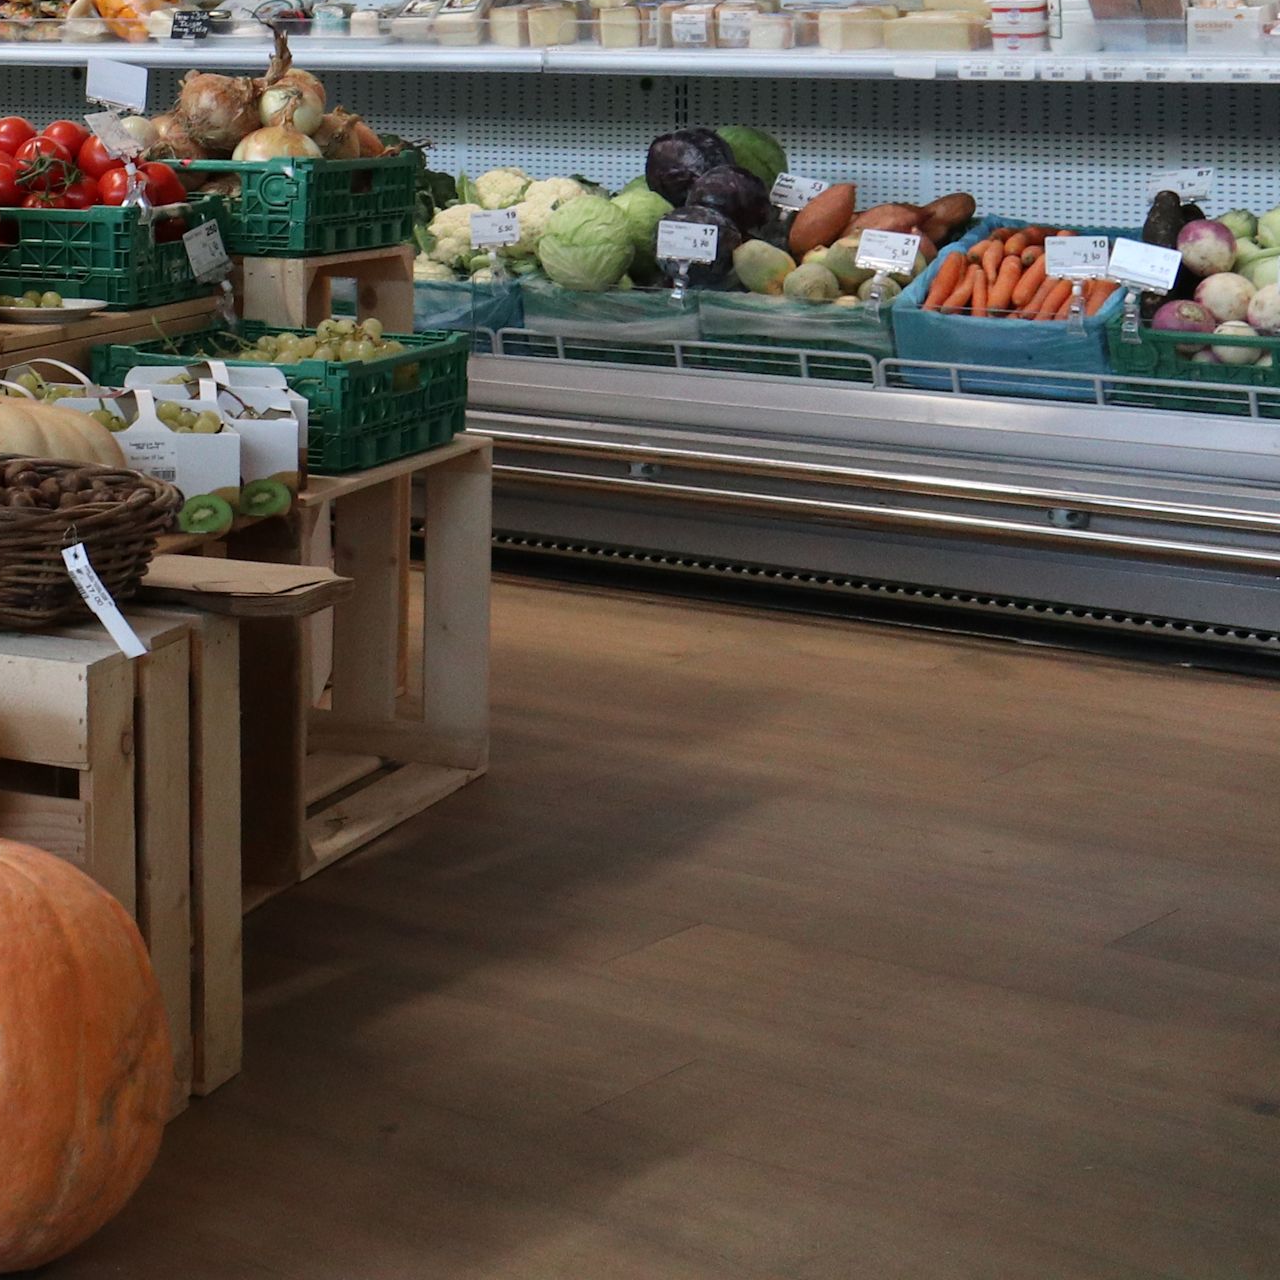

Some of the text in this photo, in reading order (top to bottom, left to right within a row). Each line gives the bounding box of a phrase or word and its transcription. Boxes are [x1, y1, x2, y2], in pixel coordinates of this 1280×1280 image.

[505, 211, 517, 220] 19
[702, 228, 715, 236] 17
[904, 238, 916, 246] 21
[1092, 239, 1106, 249] 10
